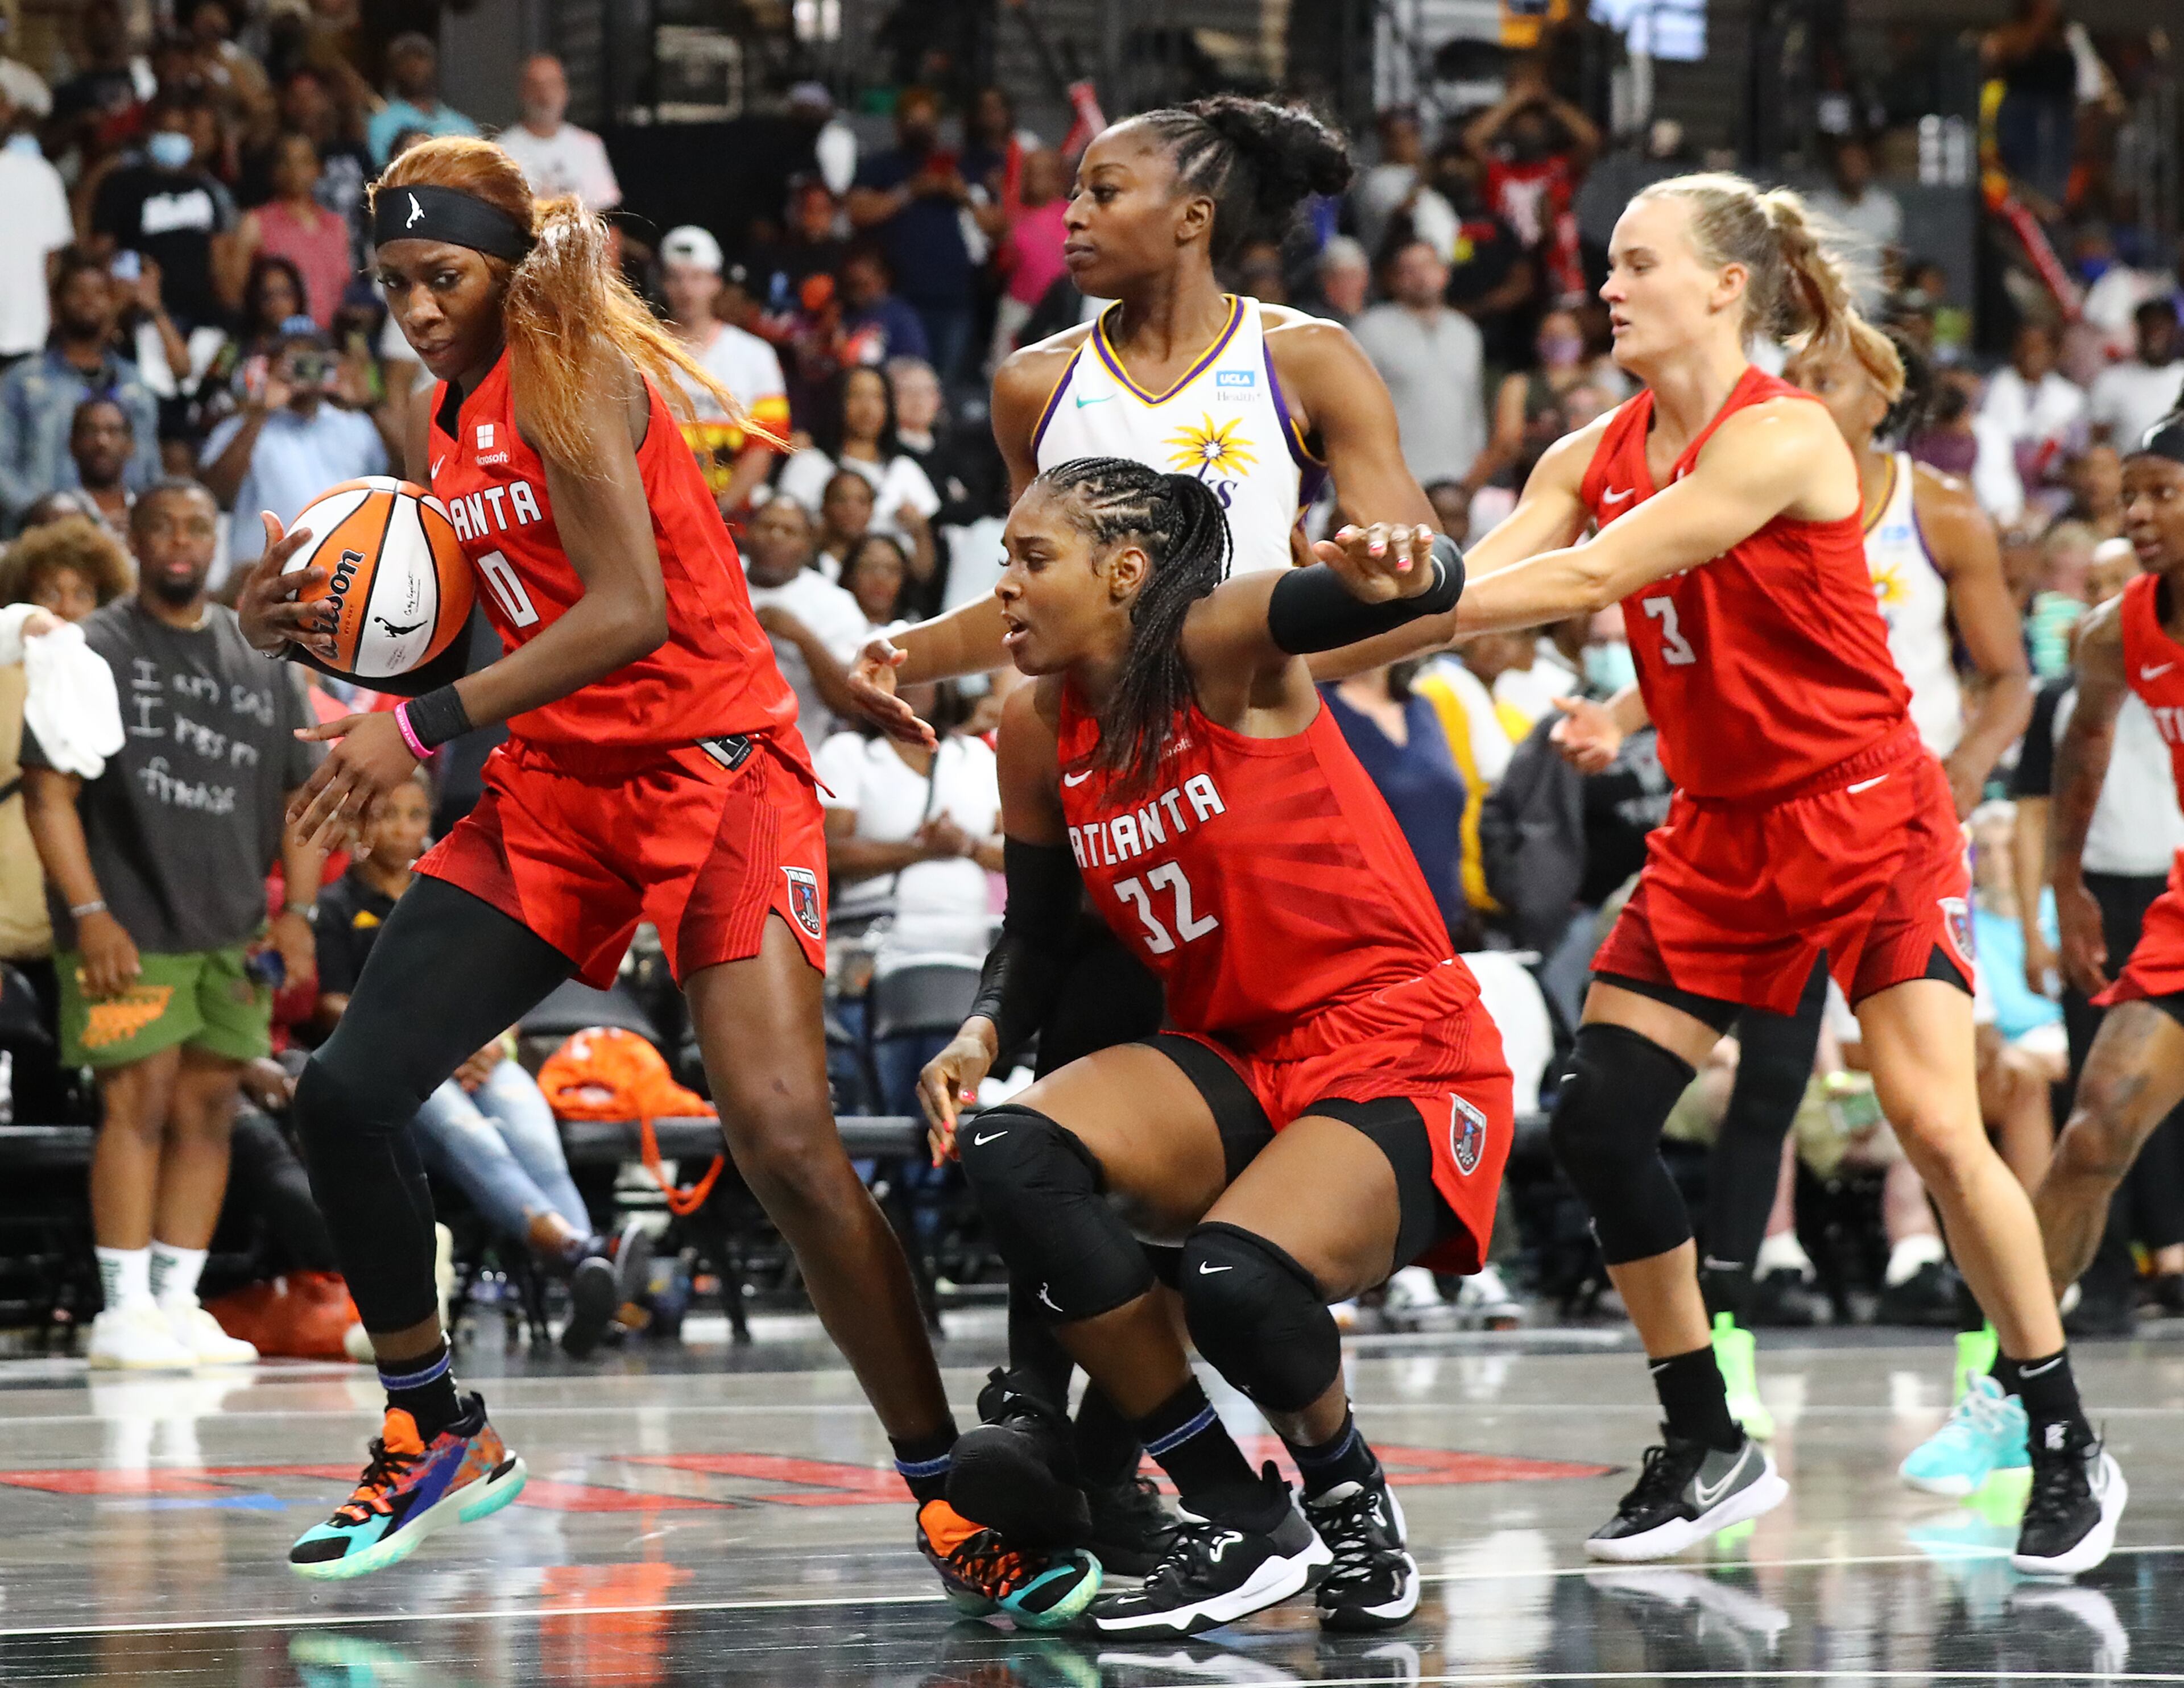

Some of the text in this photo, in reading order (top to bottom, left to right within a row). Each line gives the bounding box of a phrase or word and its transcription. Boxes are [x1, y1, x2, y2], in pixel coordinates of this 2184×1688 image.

[1217, 391, 1256, 402] Health
[1219, 373, 1251, 384] UCLA
[449, 480, 542, 542] ANTA
[1642, 596, 1697, 665] 3
[1068, 773, 1227, 869] ATLANTA
[1113, 860, 1219, 954] 32
